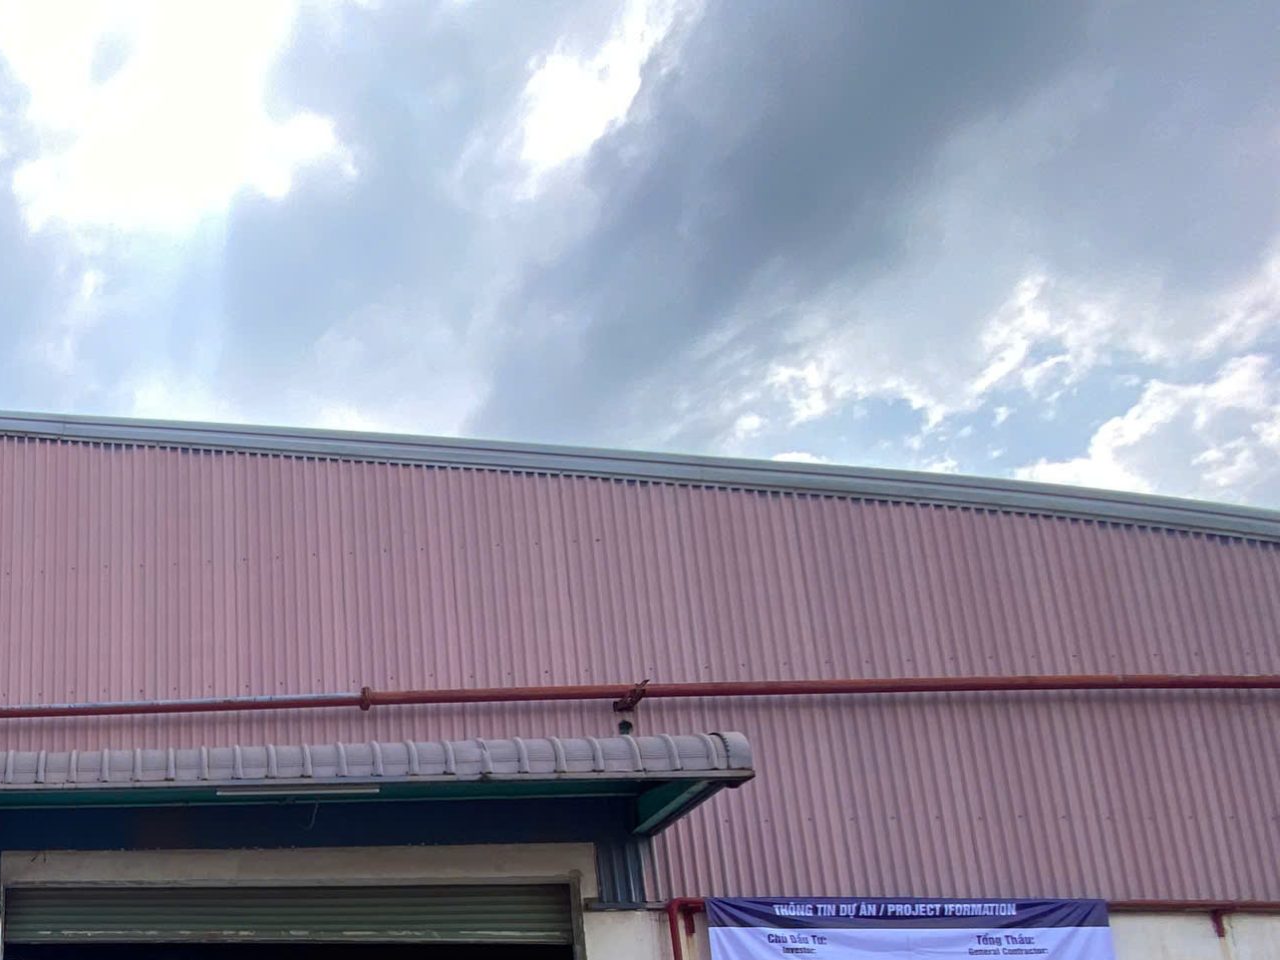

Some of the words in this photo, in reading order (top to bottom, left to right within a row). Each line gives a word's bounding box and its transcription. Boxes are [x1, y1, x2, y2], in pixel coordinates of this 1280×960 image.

[773, 902, 813, 916] THÔNG
[817, 903, 836, 916] TIN
[839, 903, 857, 919] DỰ
[888, 903, 941, 916] PROJECT
[944, 903, 1017, 916] IFORMATION
